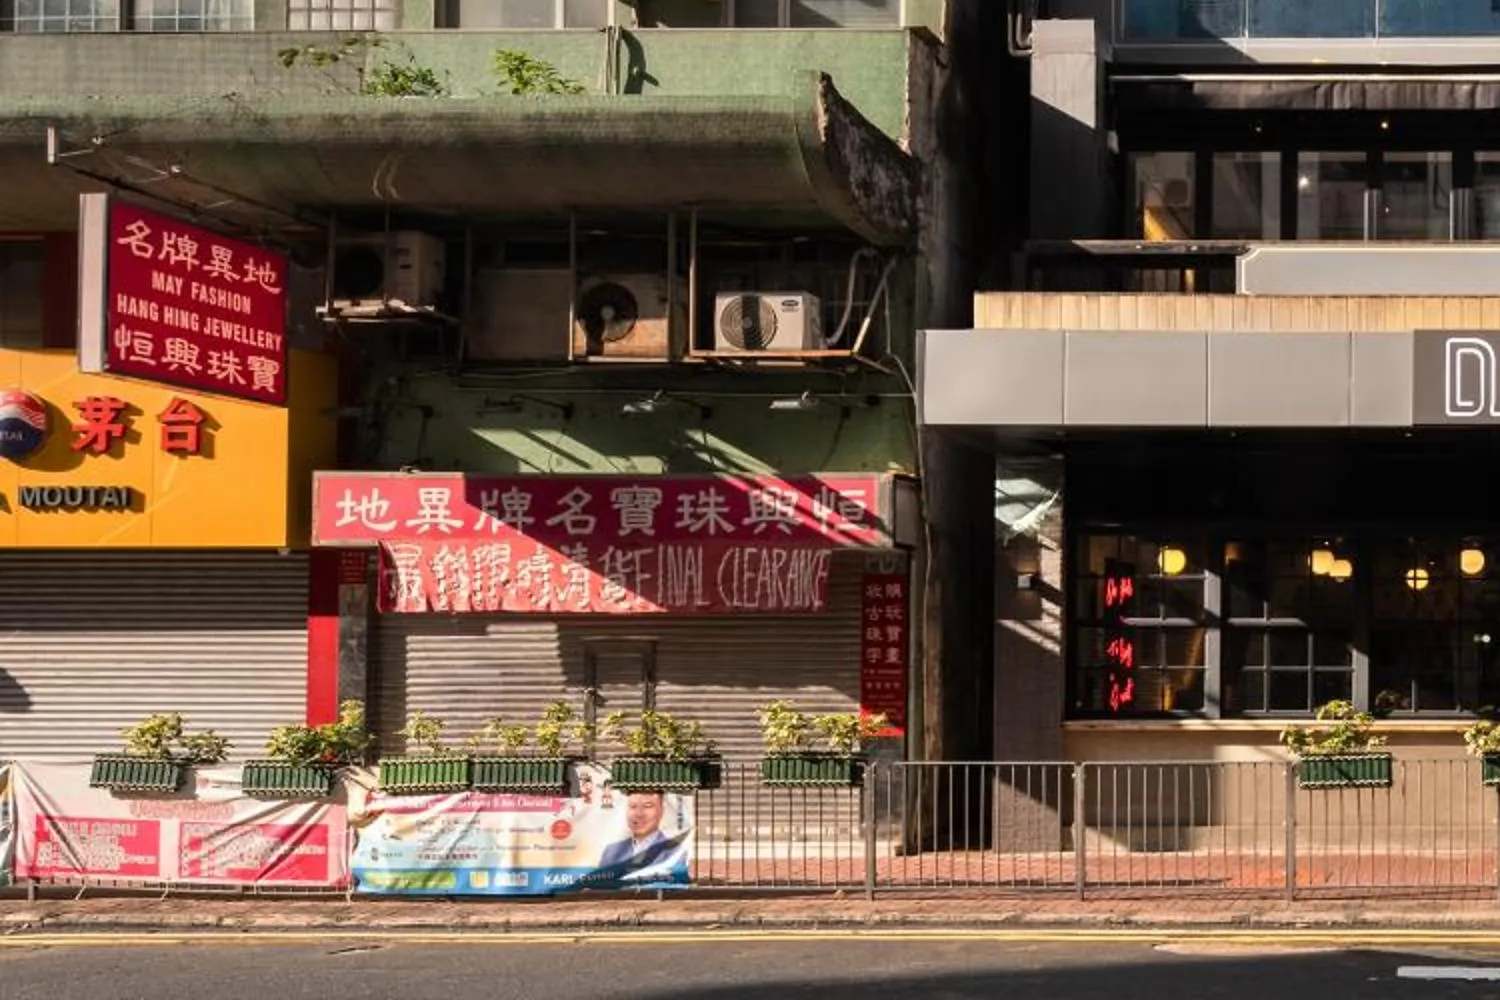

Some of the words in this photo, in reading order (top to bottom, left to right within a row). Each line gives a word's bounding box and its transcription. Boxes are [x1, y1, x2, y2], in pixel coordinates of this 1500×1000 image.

[116, 219, 282, 295] 名牌異地
[151, 269, 184, 297] MAY
[190, 280, 252, 315] FASHION
[116, 292, 160, 323] HANG
[163, 305, 200, 332] HING
[203, 316, 282, 352] JEWELLERY
[70, 396, 205, 454] 茅台
[19, 486, 129, 507] MOUTAI
